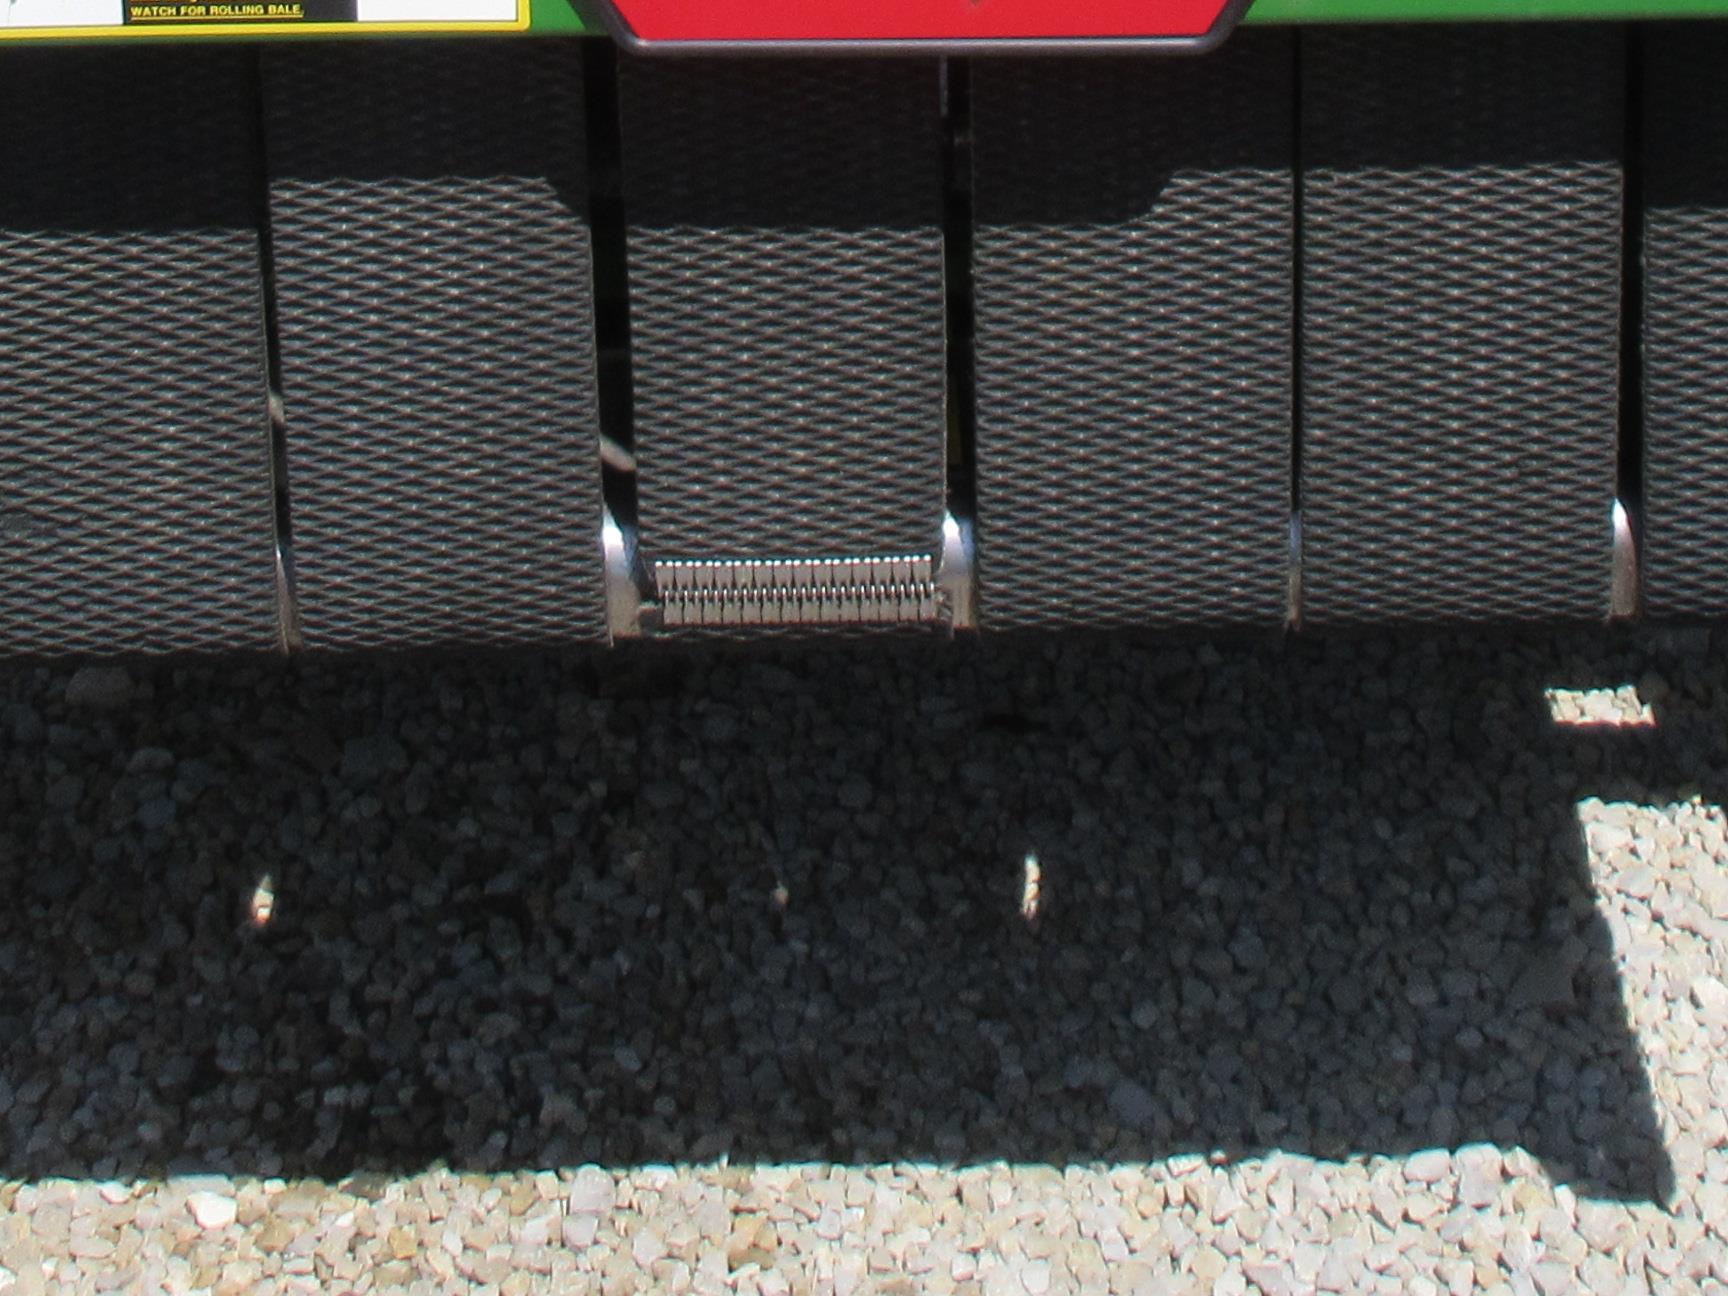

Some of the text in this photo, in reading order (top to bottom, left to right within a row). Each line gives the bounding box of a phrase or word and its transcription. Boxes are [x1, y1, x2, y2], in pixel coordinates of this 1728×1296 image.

[131, 4, 303, 17] WATCH FOR ROLLING BALE.
